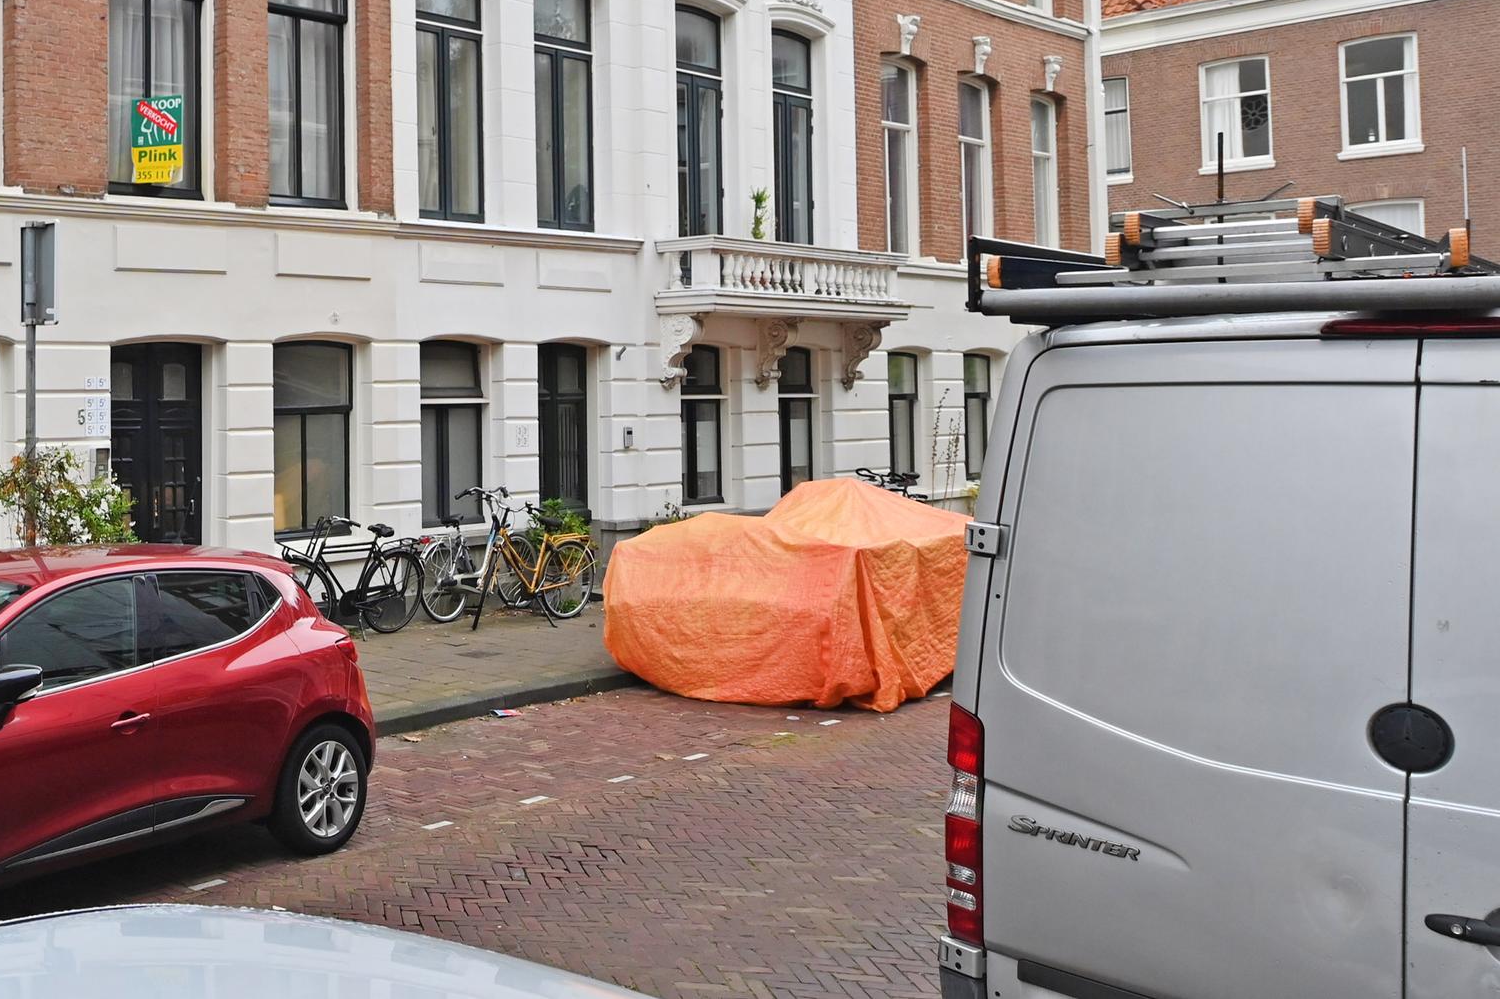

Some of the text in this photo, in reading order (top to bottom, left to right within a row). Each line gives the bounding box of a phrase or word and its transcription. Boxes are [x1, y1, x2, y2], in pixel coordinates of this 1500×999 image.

[151, 98, 181, 110] KOOP
[139, 103, 175, 132] VERKOCHT
[138, 148, 177, 163] Plink
[77, 408, 85, 425] 5
[1007, 814, 1141, 862] SPRINTER
